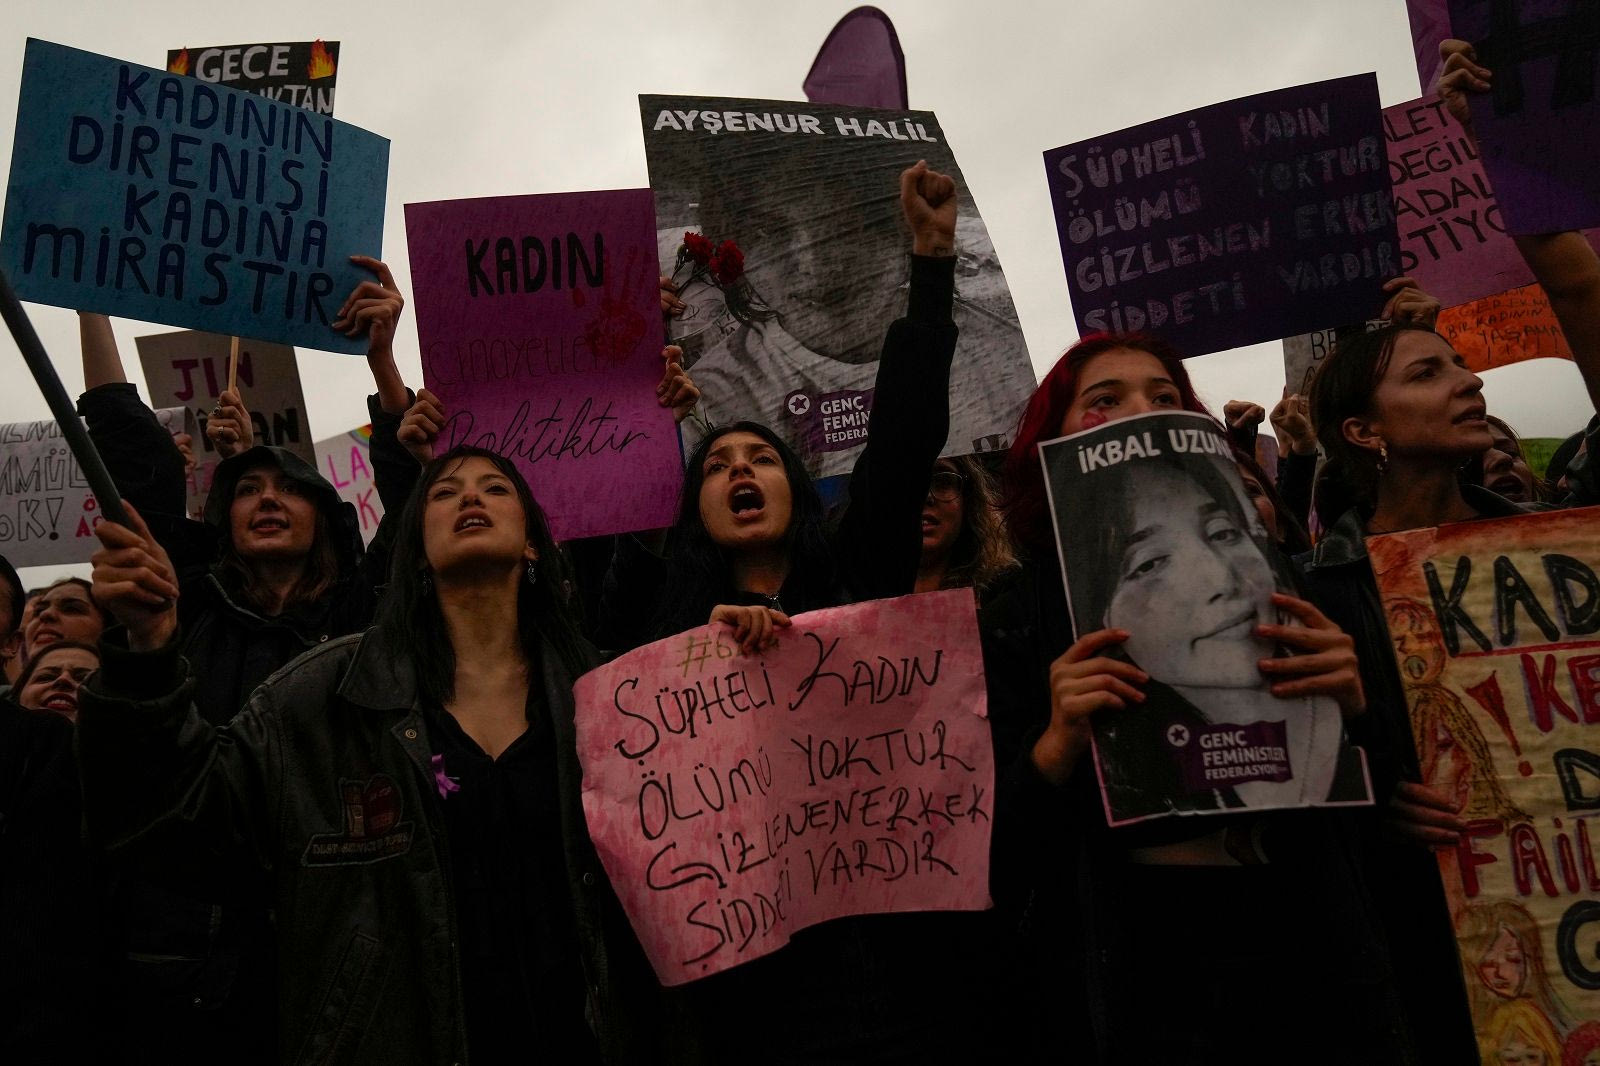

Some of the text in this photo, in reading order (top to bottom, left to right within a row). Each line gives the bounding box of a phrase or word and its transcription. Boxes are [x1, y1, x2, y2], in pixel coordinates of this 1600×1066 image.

[195, 45, 291, 83] GECE
[115, 64, 333, 163] KADININ
[654, 110, 938, 143] AYŞENUR HALİL
[1058, 102, 1331, 207] ŞÜPHELİ KADIN
[1068, 136, 1381, 244] ÖLÜMÜ YOKTUR
[124, 184, 328, 268] KADINA
[1076, 189, 1396, 292] GİZLENEN ERKEK
[465, 232, 605, 297] KADIN
[1277, 241, 1397, 295] VARDIR
[820, 396, 864, 415] GENÇ
[825, 428, 869, 444] FEDERA
[1077, 431, 1162, 474] İKBAL
[614, 632, 943, 767] ŞÜPHELİ KADIN
[790, 719, 976, 787] YOKTUR
[1200, 730, 1248, 749] GENÇ
[804, 831, 959, 896] VARDIR
